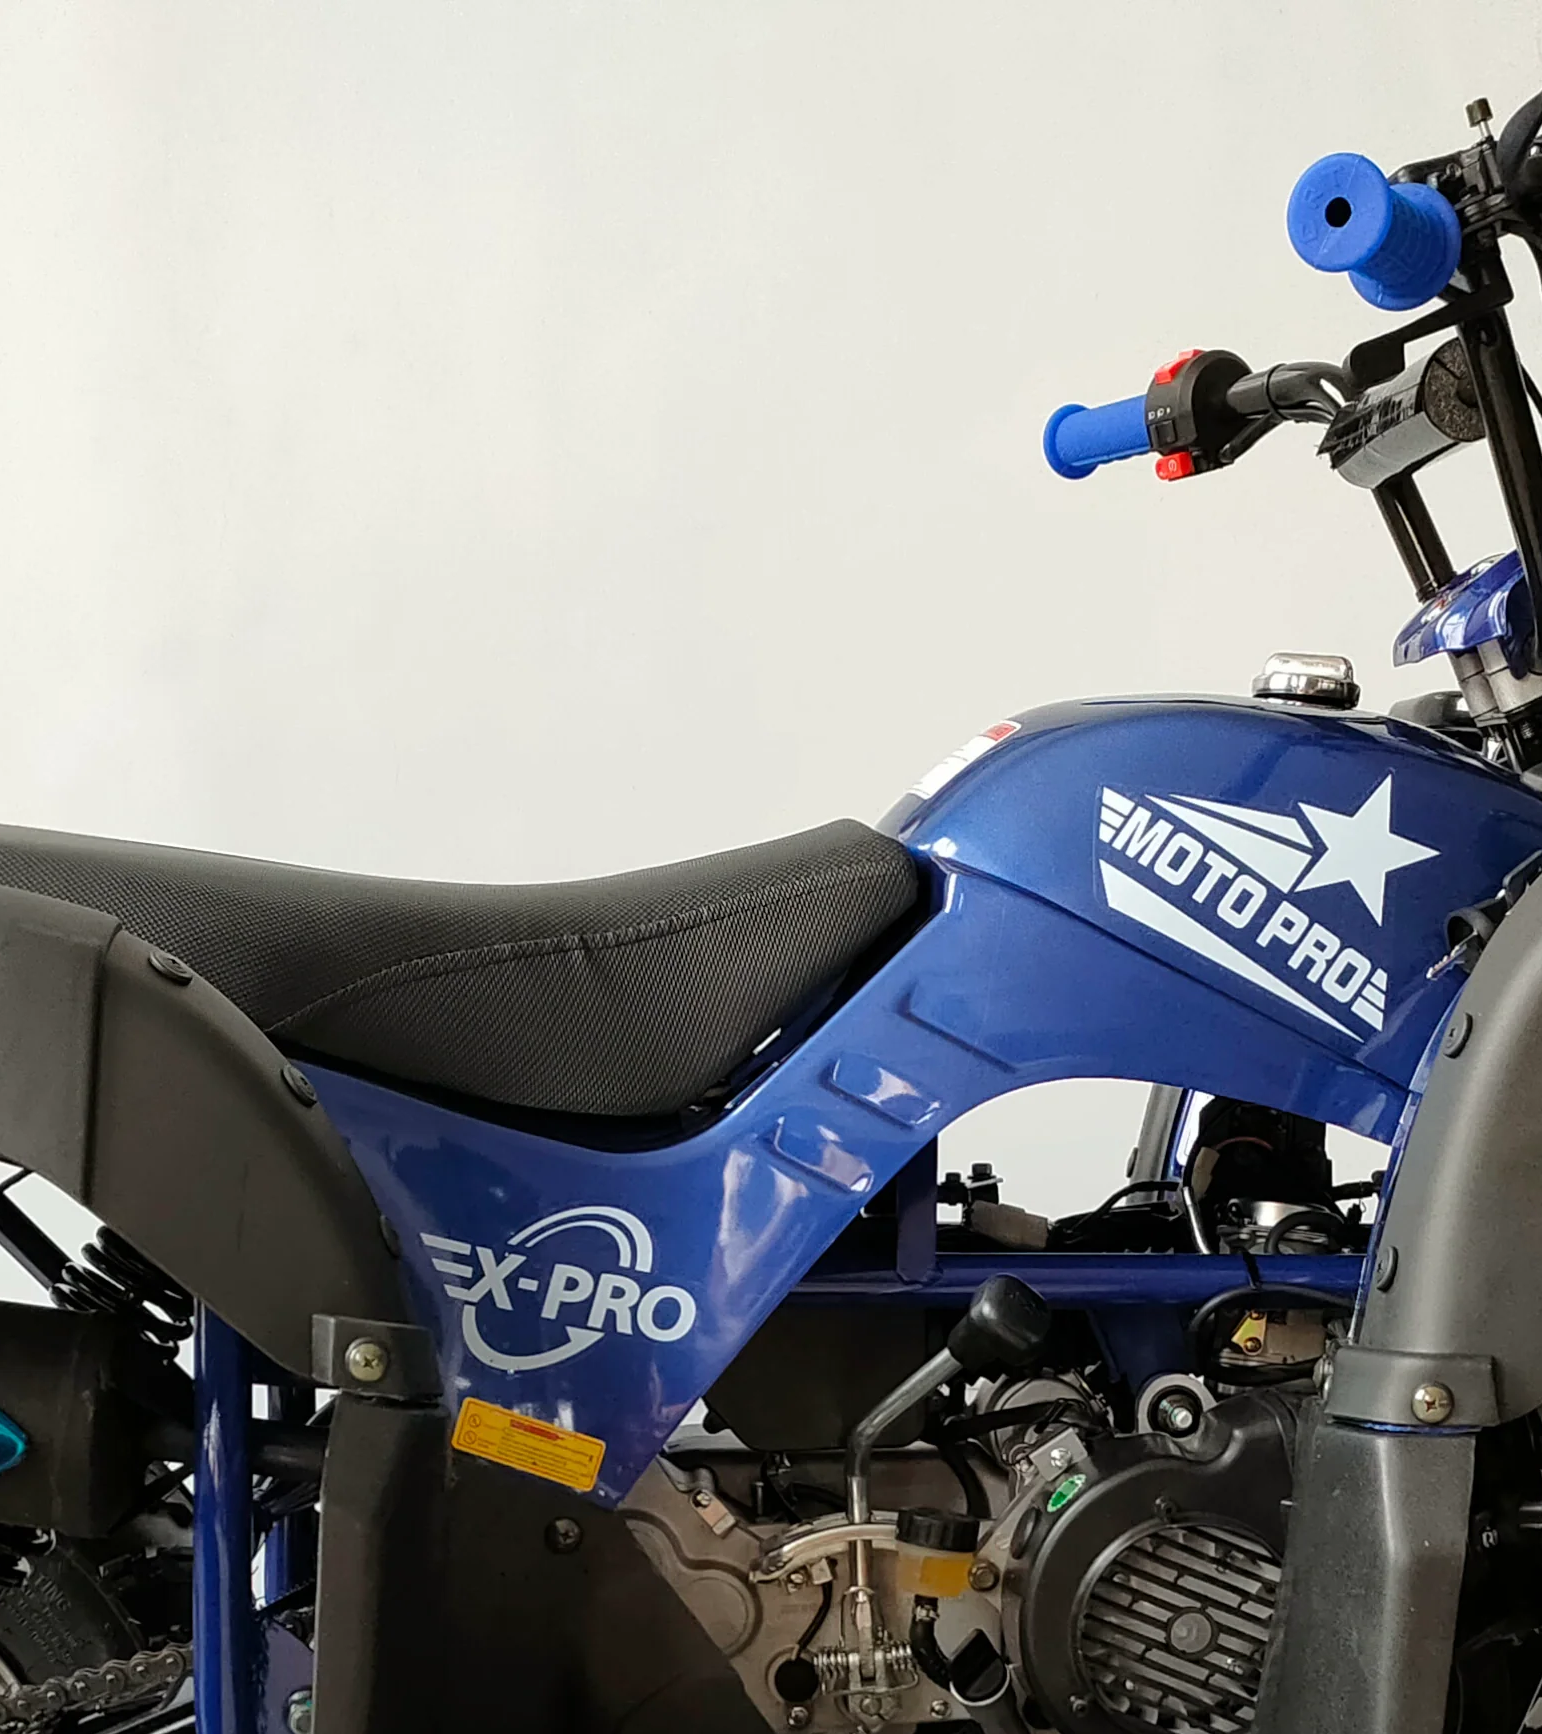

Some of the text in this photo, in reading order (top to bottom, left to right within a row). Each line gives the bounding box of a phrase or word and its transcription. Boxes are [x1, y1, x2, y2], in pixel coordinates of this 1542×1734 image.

[1112, 801, 1371, 1004] MOTO PRO
[447, 1244, 697, 1343] X-PRO
